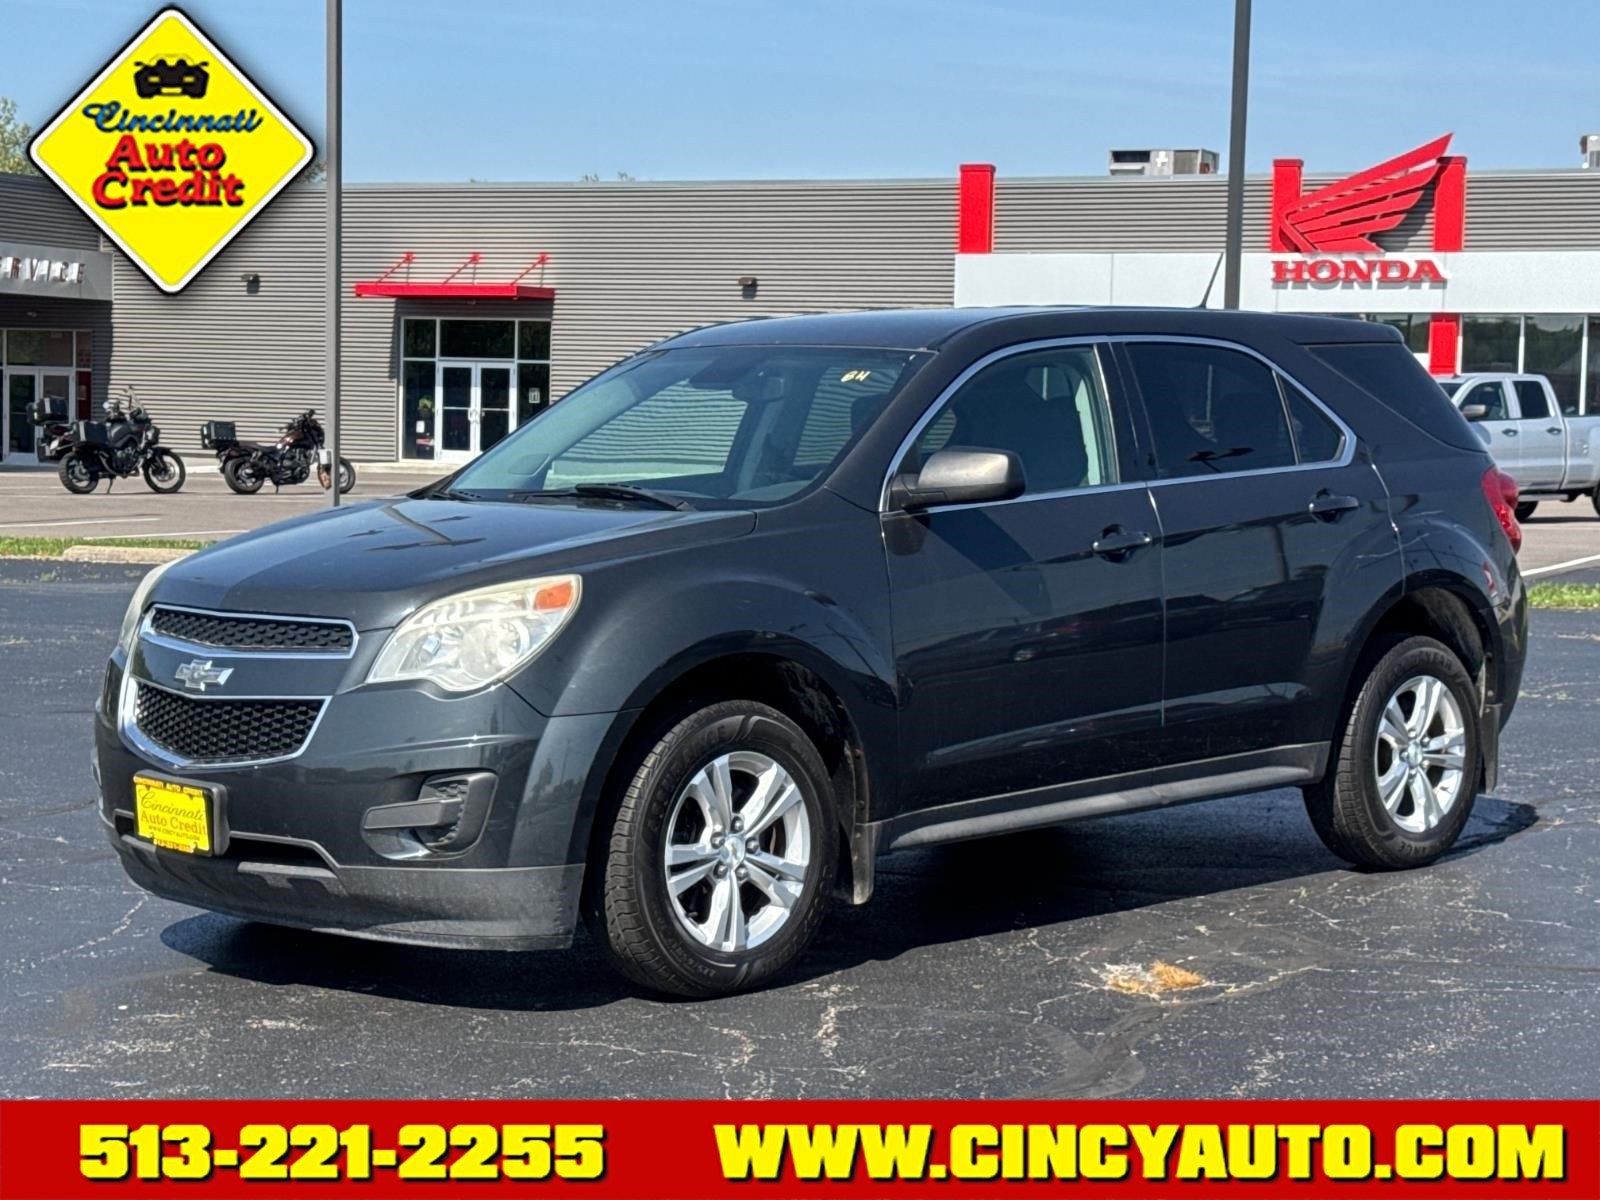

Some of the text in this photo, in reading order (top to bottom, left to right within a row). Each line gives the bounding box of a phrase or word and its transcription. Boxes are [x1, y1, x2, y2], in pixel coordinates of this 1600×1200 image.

[1272, 260, 1446, 287] HONDA
[138, 788, 204, 821] Cincinnati
[140, 810, 207, 836] Auto Credit
